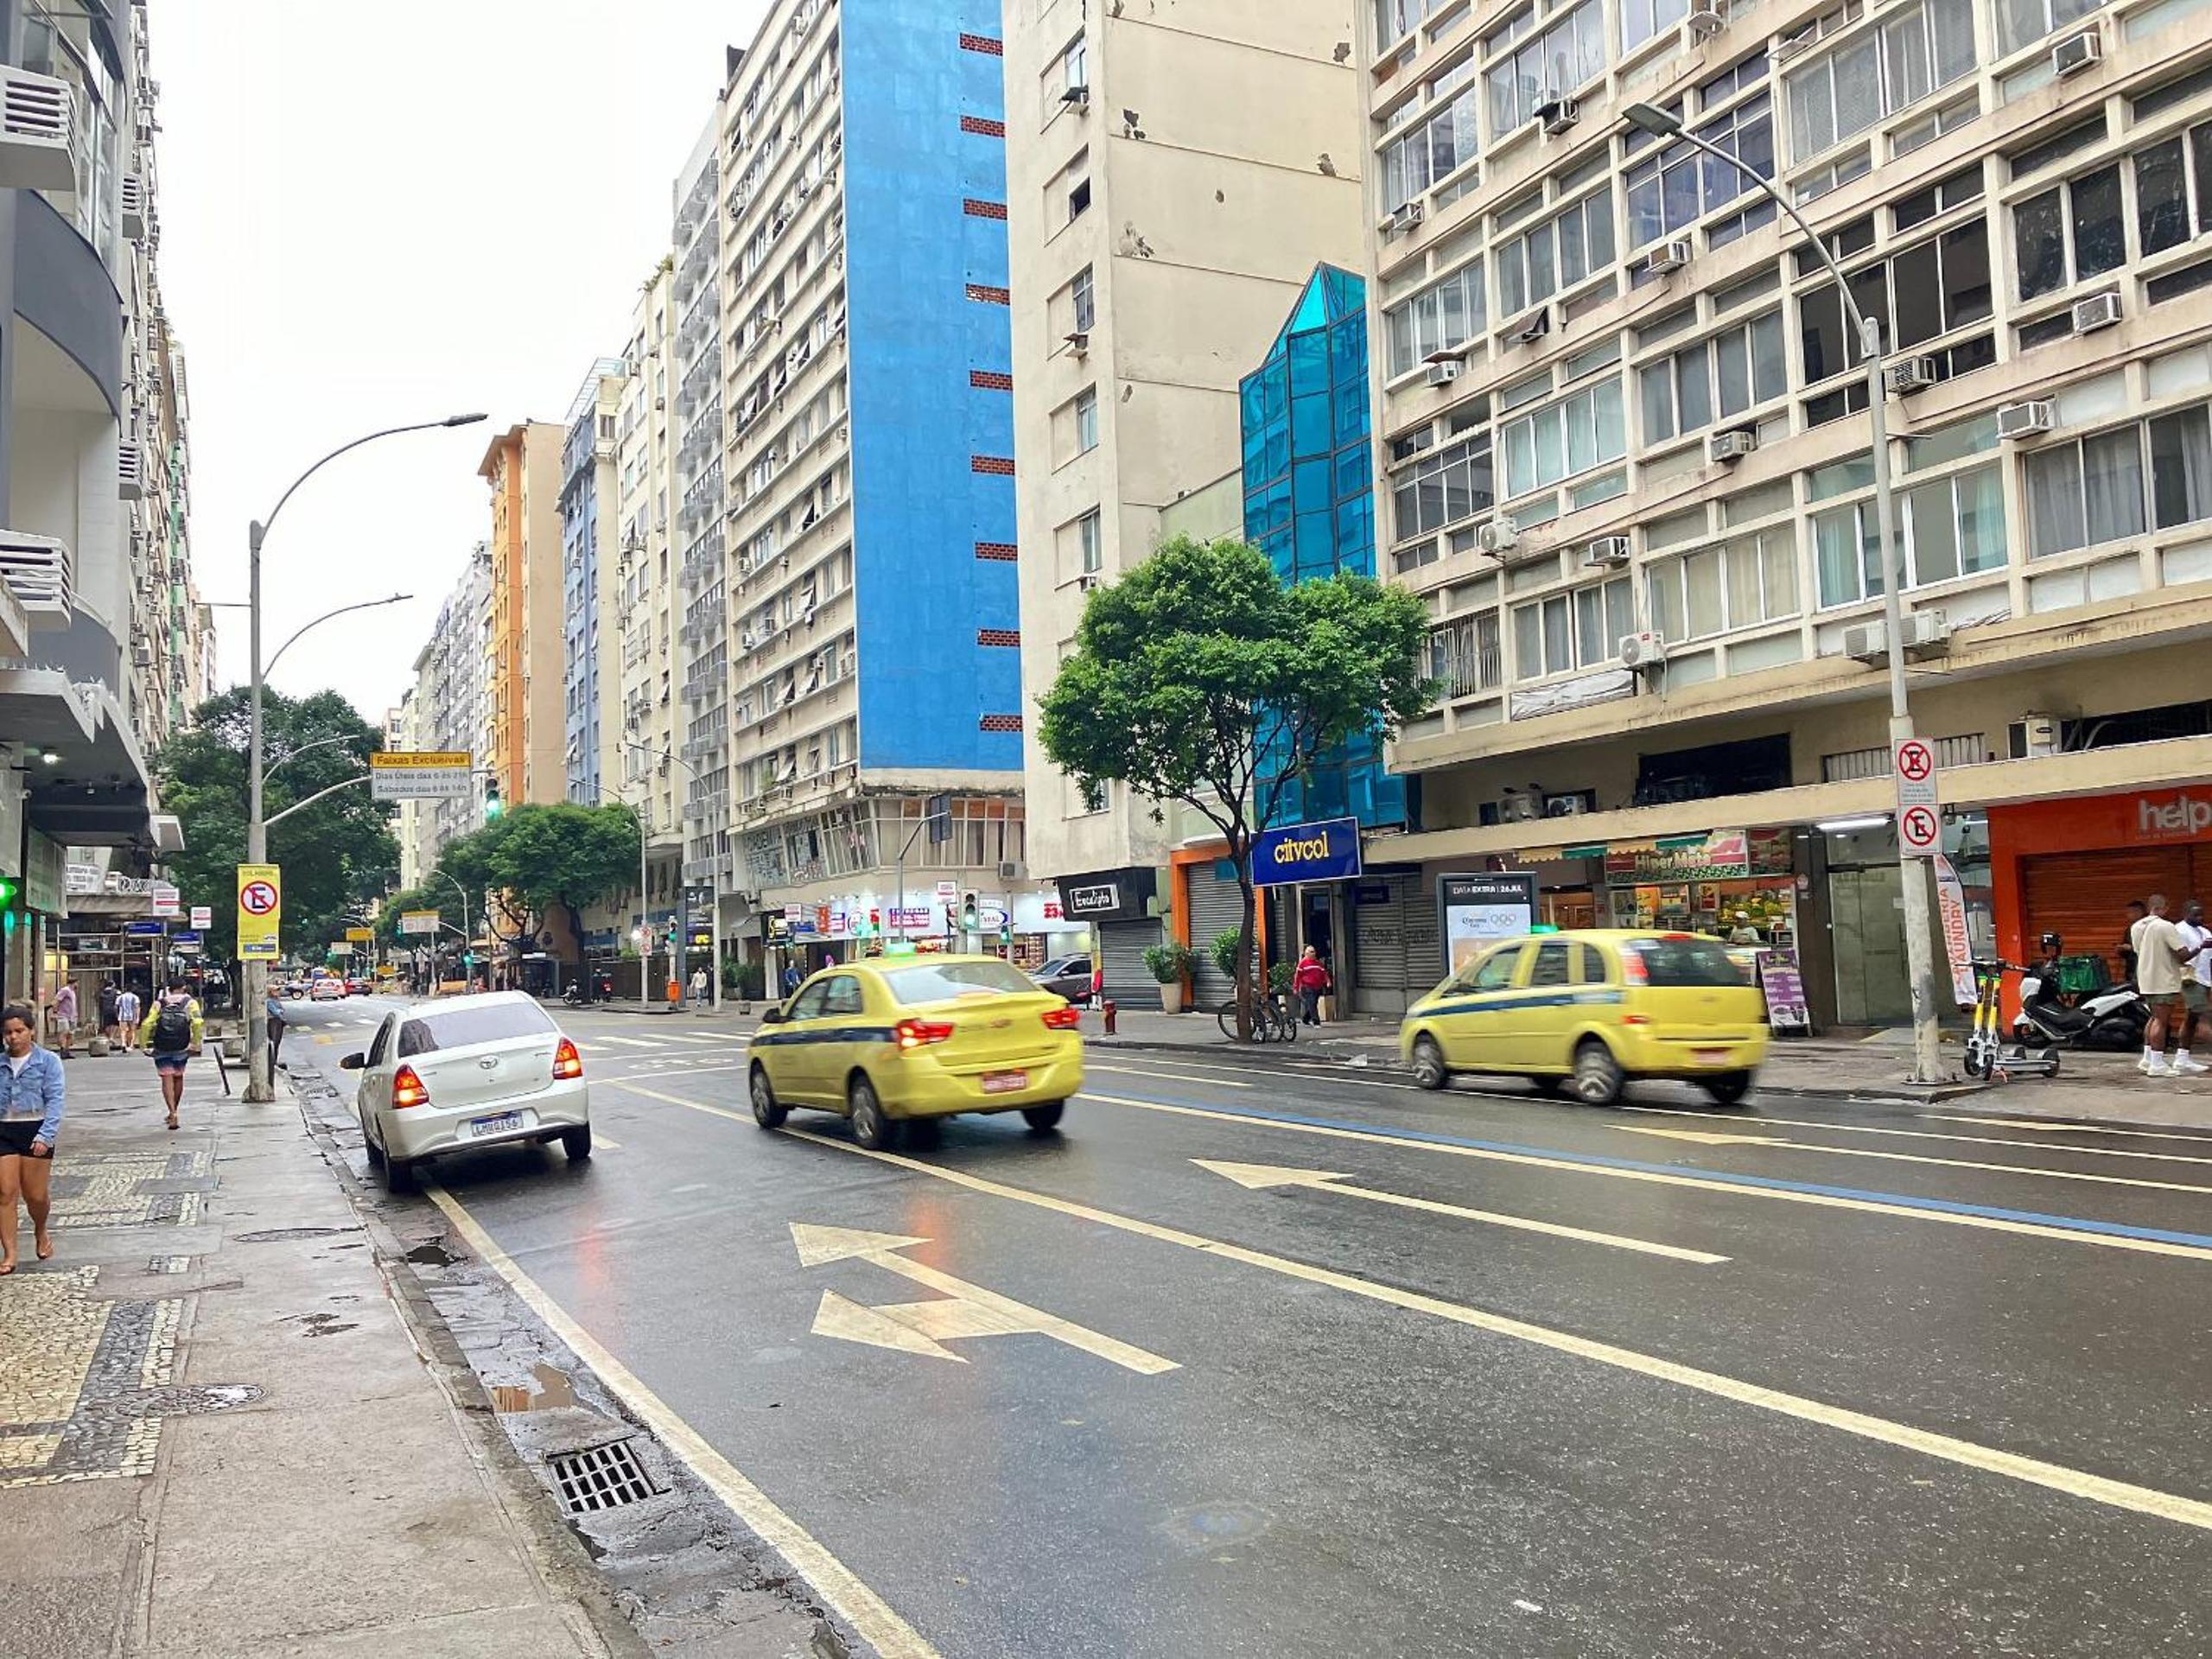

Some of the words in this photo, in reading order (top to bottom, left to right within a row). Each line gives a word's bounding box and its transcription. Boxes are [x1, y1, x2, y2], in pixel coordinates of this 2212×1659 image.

[376, 756, 410, 765] Faixas
[412, 754, 466, 764] Exclusivas
[2139, 796, 2210, 834] help
